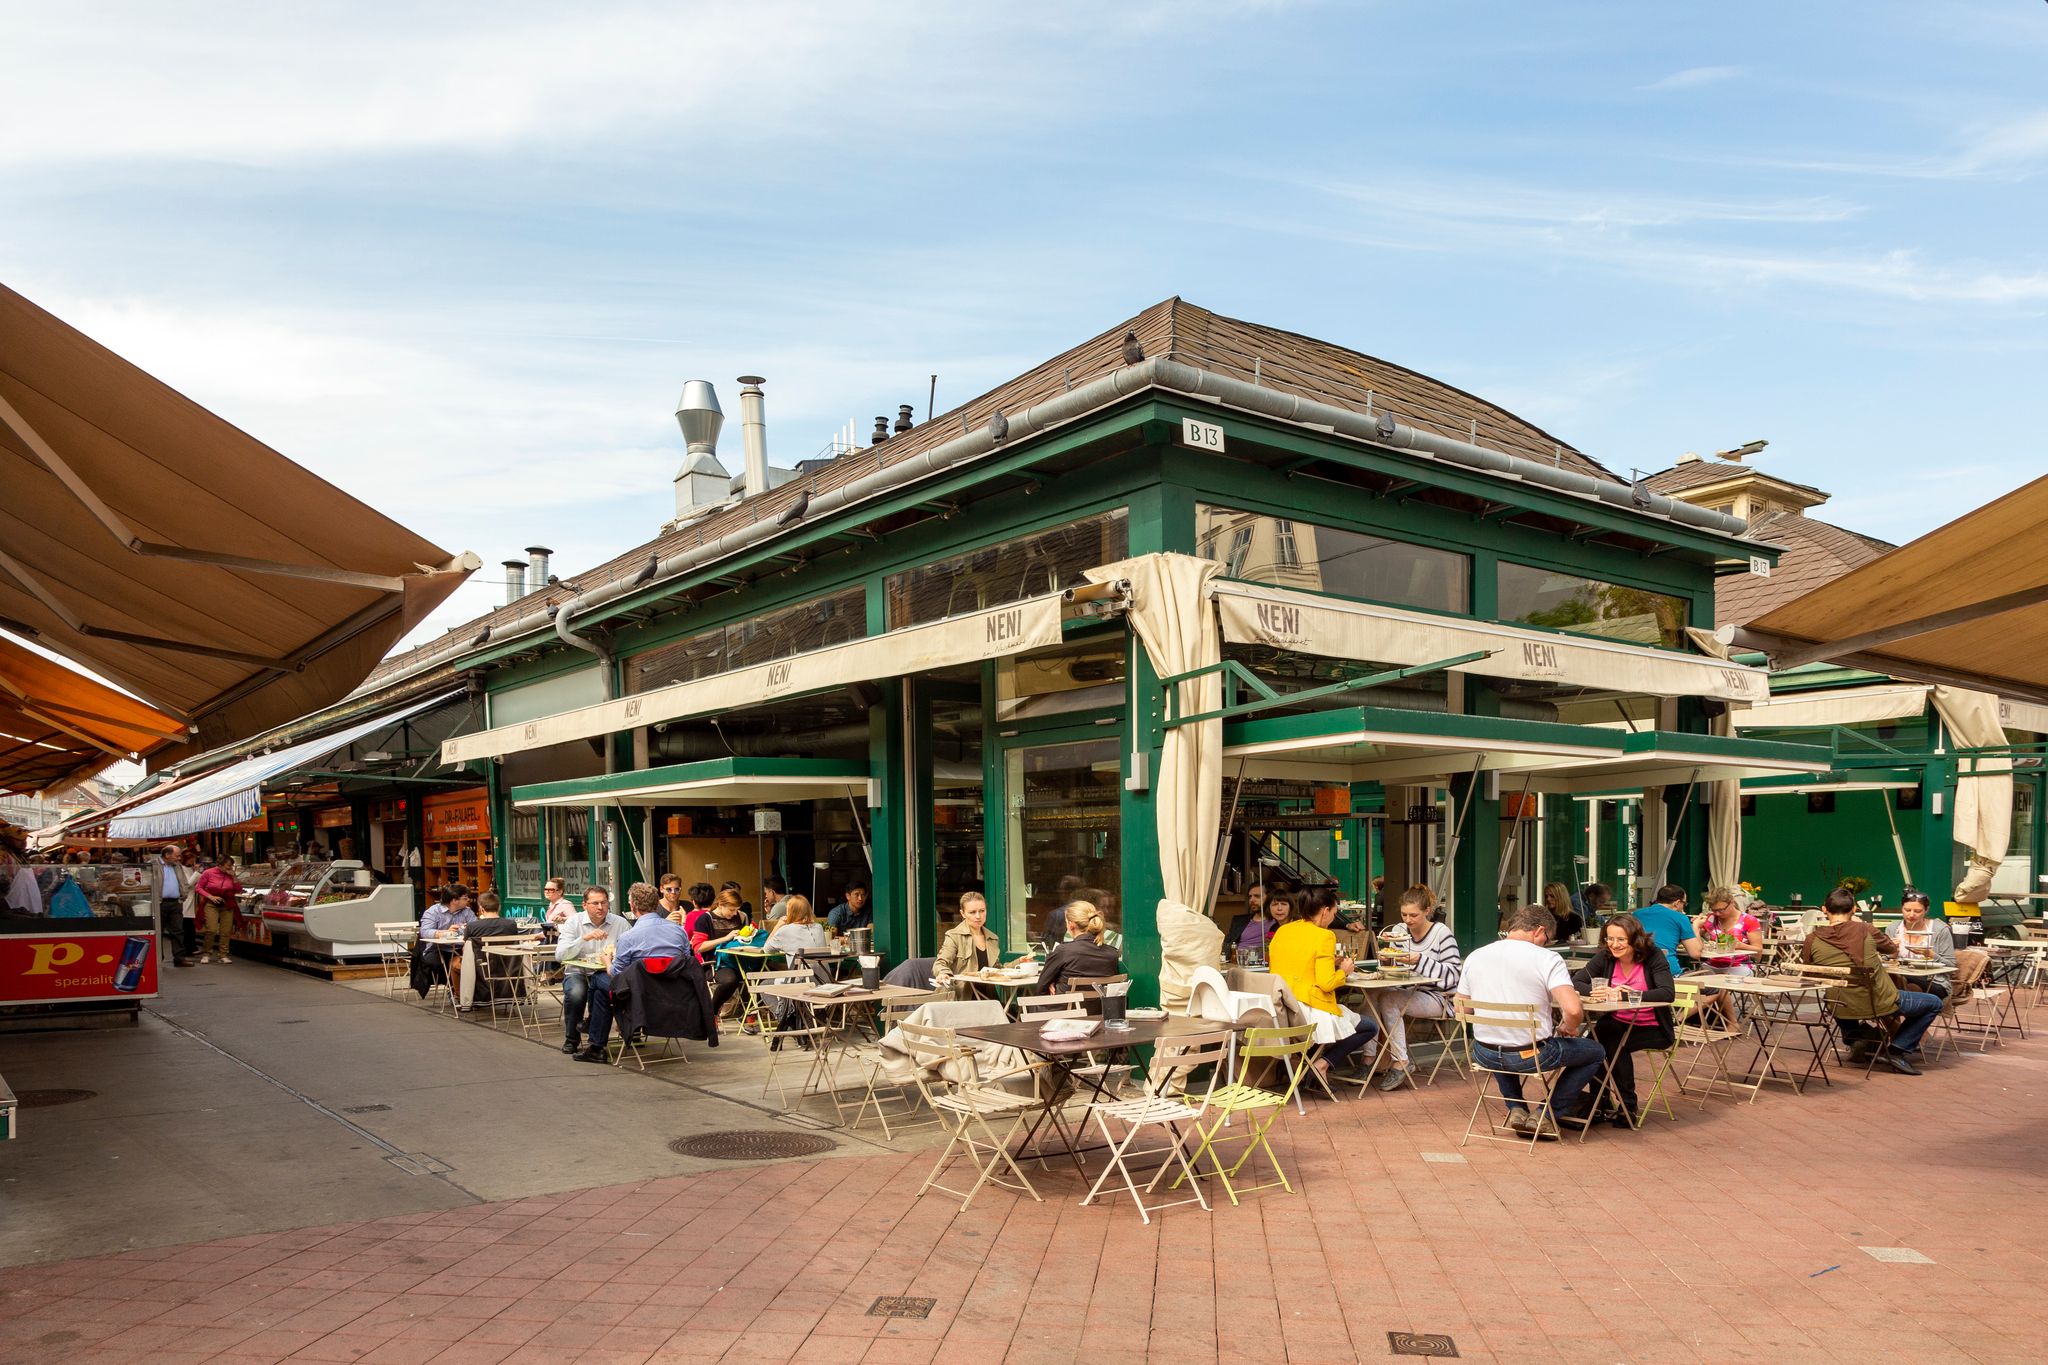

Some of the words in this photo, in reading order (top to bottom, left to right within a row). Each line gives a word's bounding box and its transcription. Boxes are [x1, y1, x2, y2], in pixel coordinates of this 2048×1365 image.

[1190, 423, 1201, 442] B
[1204, 427, 1218, 446] 13
[1753, 559, 1760, 572] B
[1760, 561, 1767, 574] 13
[986, 609, 1022, 643] NENI
[1256, 602, 1300, 635] NENI
[1522, 642, 1558, 668] NENI
[766, 662, 792, 687] NENI
[1720, 669, 1749, 690] NENI
[624, 698, 643, 719] NENI
[524, 723, 538, 741] NENI
[515, 864, 528, 881] You
[529, 869, 541, 881] are
[556, 862, 578, 879] what
[54, 974, 146, 990] spezialitn
